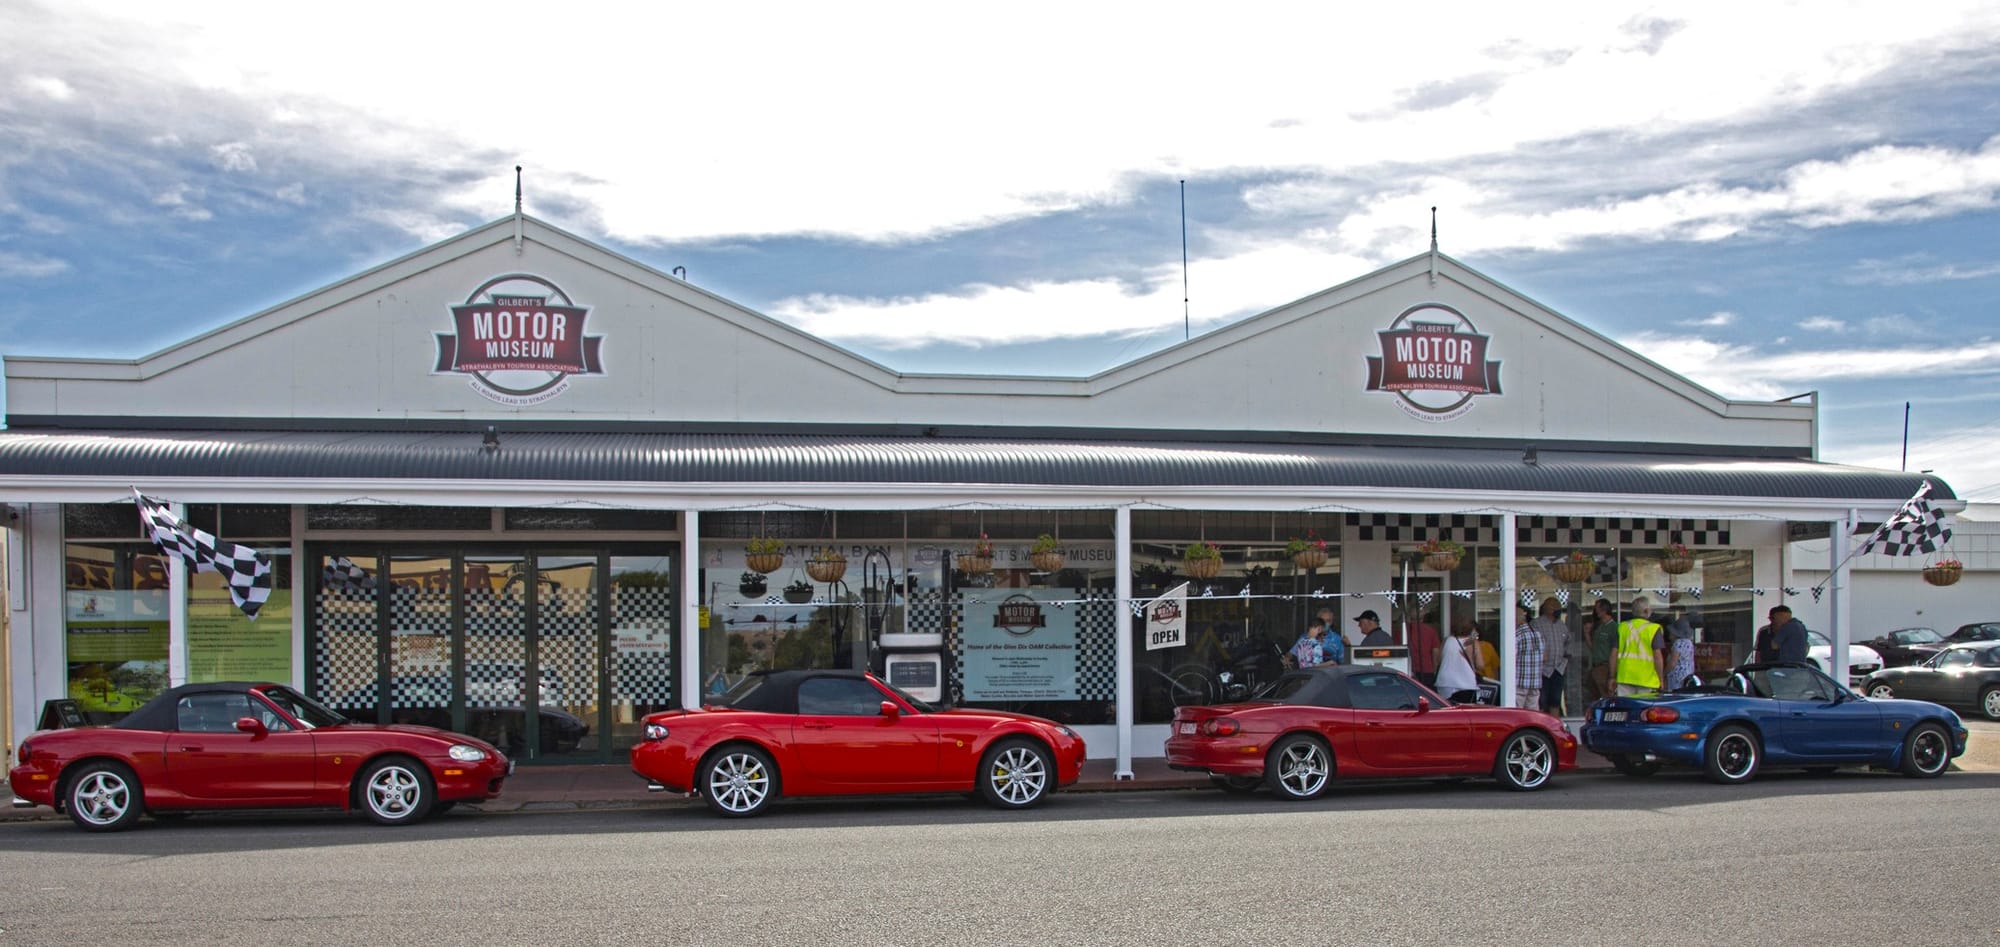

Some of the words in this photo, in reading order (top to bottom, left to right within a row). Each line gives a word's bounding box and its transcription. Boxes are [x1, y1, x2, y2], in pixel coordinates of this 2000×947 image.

[498, 298, 541, 307] GILBERT'S
[473, 311, 567, 341] MOTOR
[1416, 324, 1452, 333] GILBERT'S
[486, 341, 555, 359] MUSEUM
[1395, 336, 1473, 365] MOTOR
[461, 363, 506, 371] STRATHALBYN
[537, 363, 579, 372] ASSOCIATION
[1407, 363, 1464, 381] MUSEUM
[471, 381, 481, 391] ALL
[481, 388, 501, 402] ROADS
[501, 396, 518, 404] LEAD
[528, 383, 568, 404] STRATHALBYN
[1449, 384, 1483, 392] ASSOCIATION
[1070, 549, 1116, 561] MUSEU
[1004, 606, 1035, 617] MOTOR
[1152, 628, 1180, 645] OPEN
